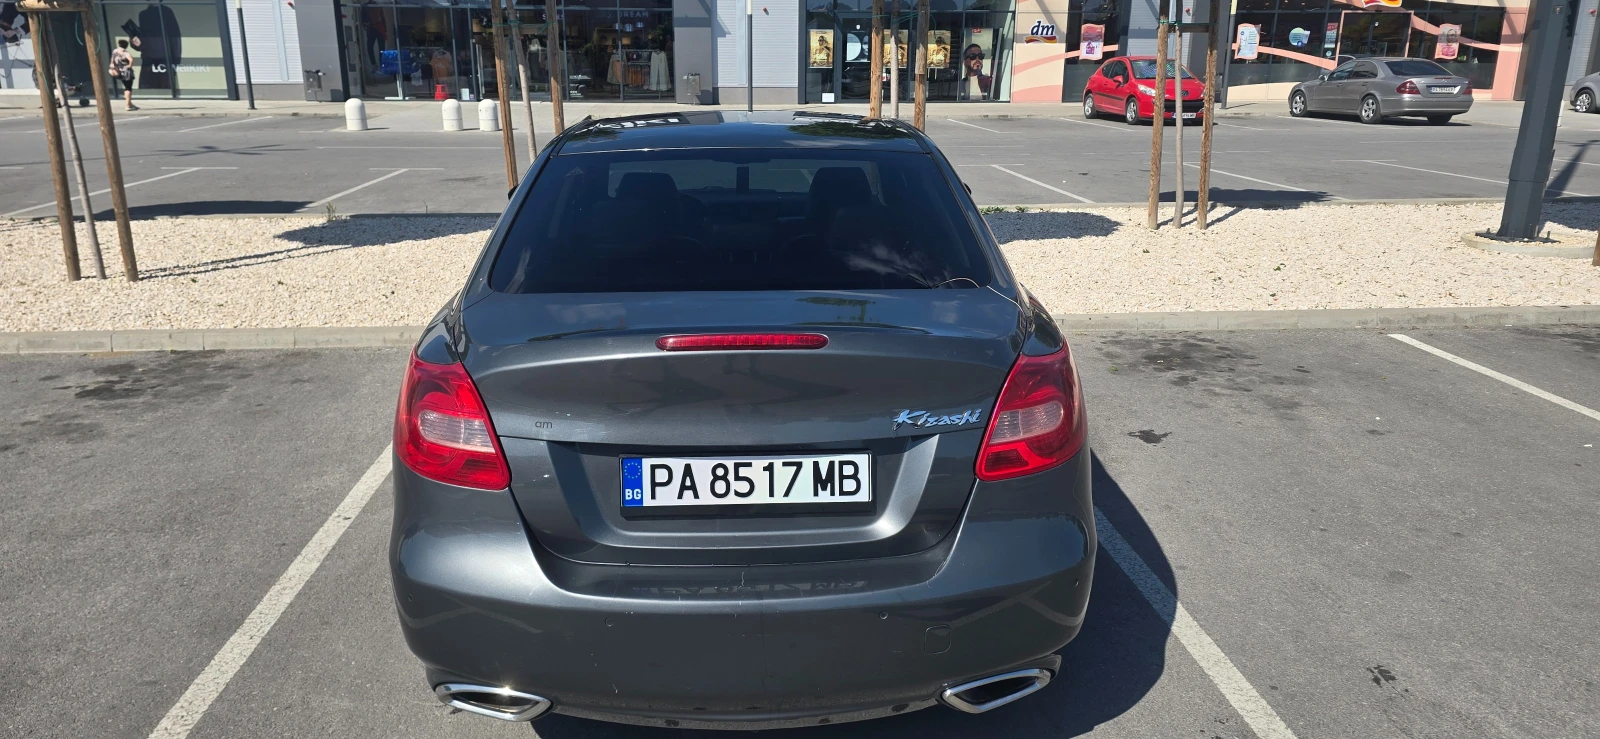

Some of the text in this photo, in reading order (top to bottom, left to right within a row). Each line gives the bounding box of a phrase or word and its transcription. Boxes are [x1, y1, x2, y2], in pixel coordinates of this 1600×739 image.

[1030, 21, 1055, 36] dm
[151, 63, 167, 73] LC
[534, 421, 553, 429] am
[892, 408, 982, 431] Kizashi
[649, 459, 862, 500] PA 8517 MB
[625, 488, 642, 500] BG
